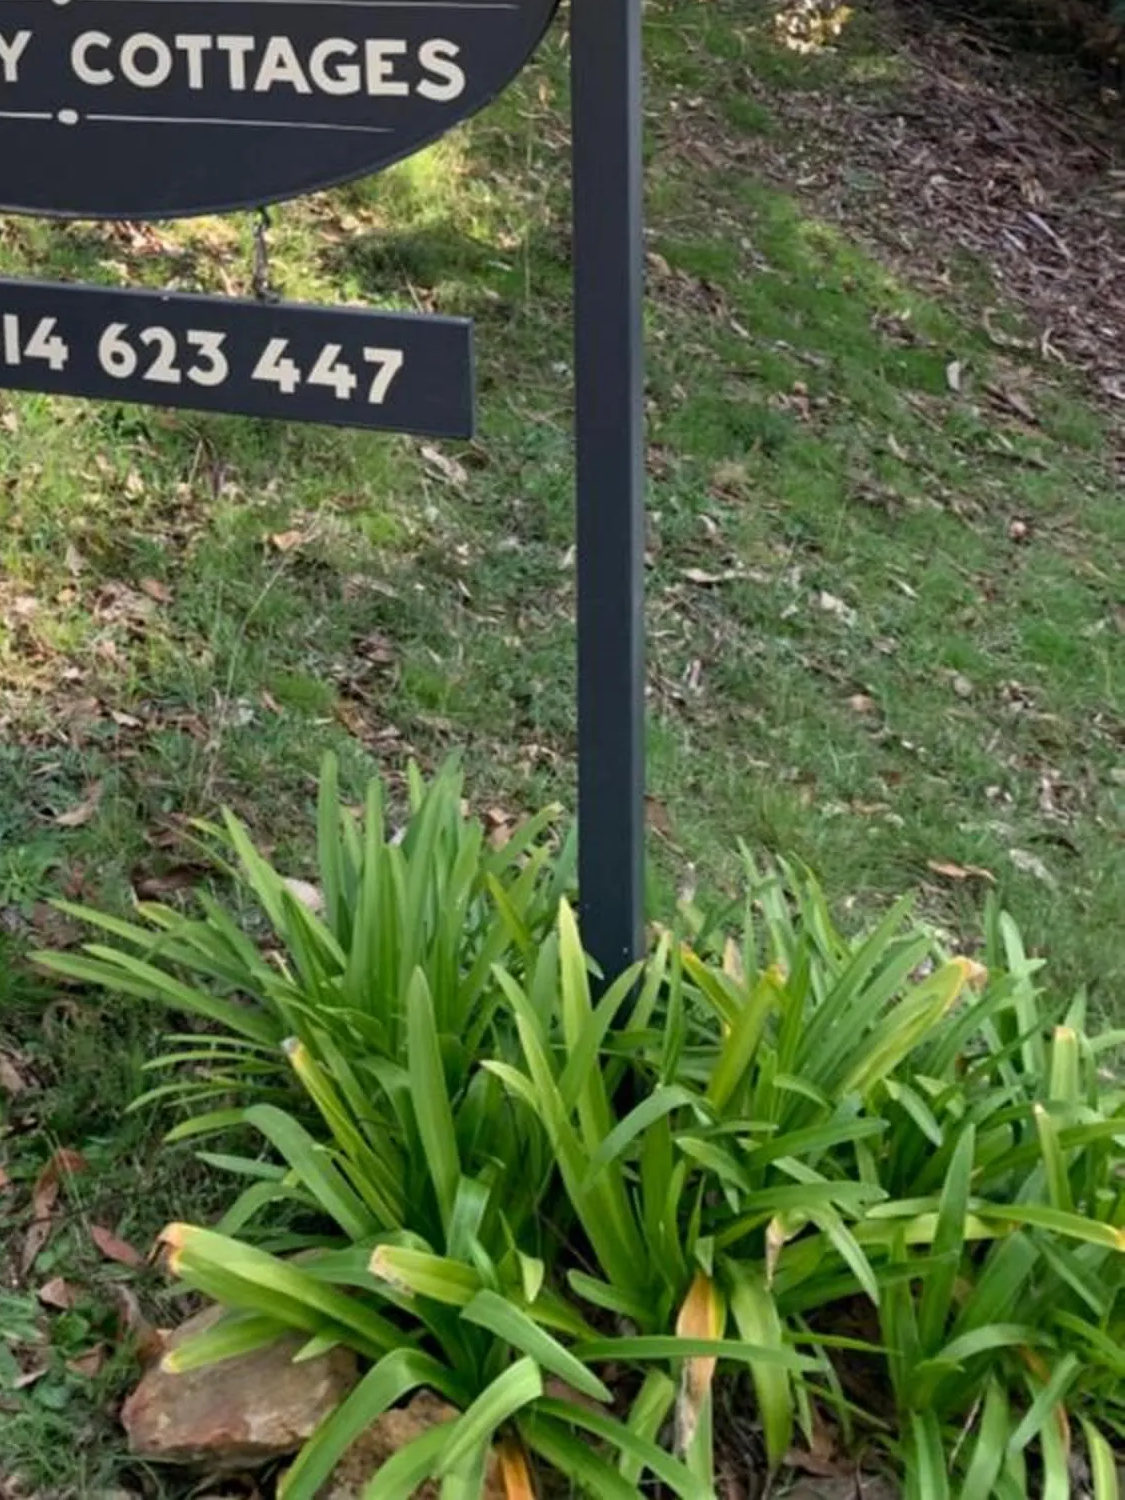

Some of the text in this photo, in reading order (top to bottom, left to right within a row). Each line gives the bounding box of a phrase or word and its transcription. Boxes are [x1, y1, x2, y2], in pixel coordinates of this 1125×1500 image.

[72, 32, 467, 102] COTTAGES
[98, 323, 228, 387] 623
[251, 339, 405, 405] 447
